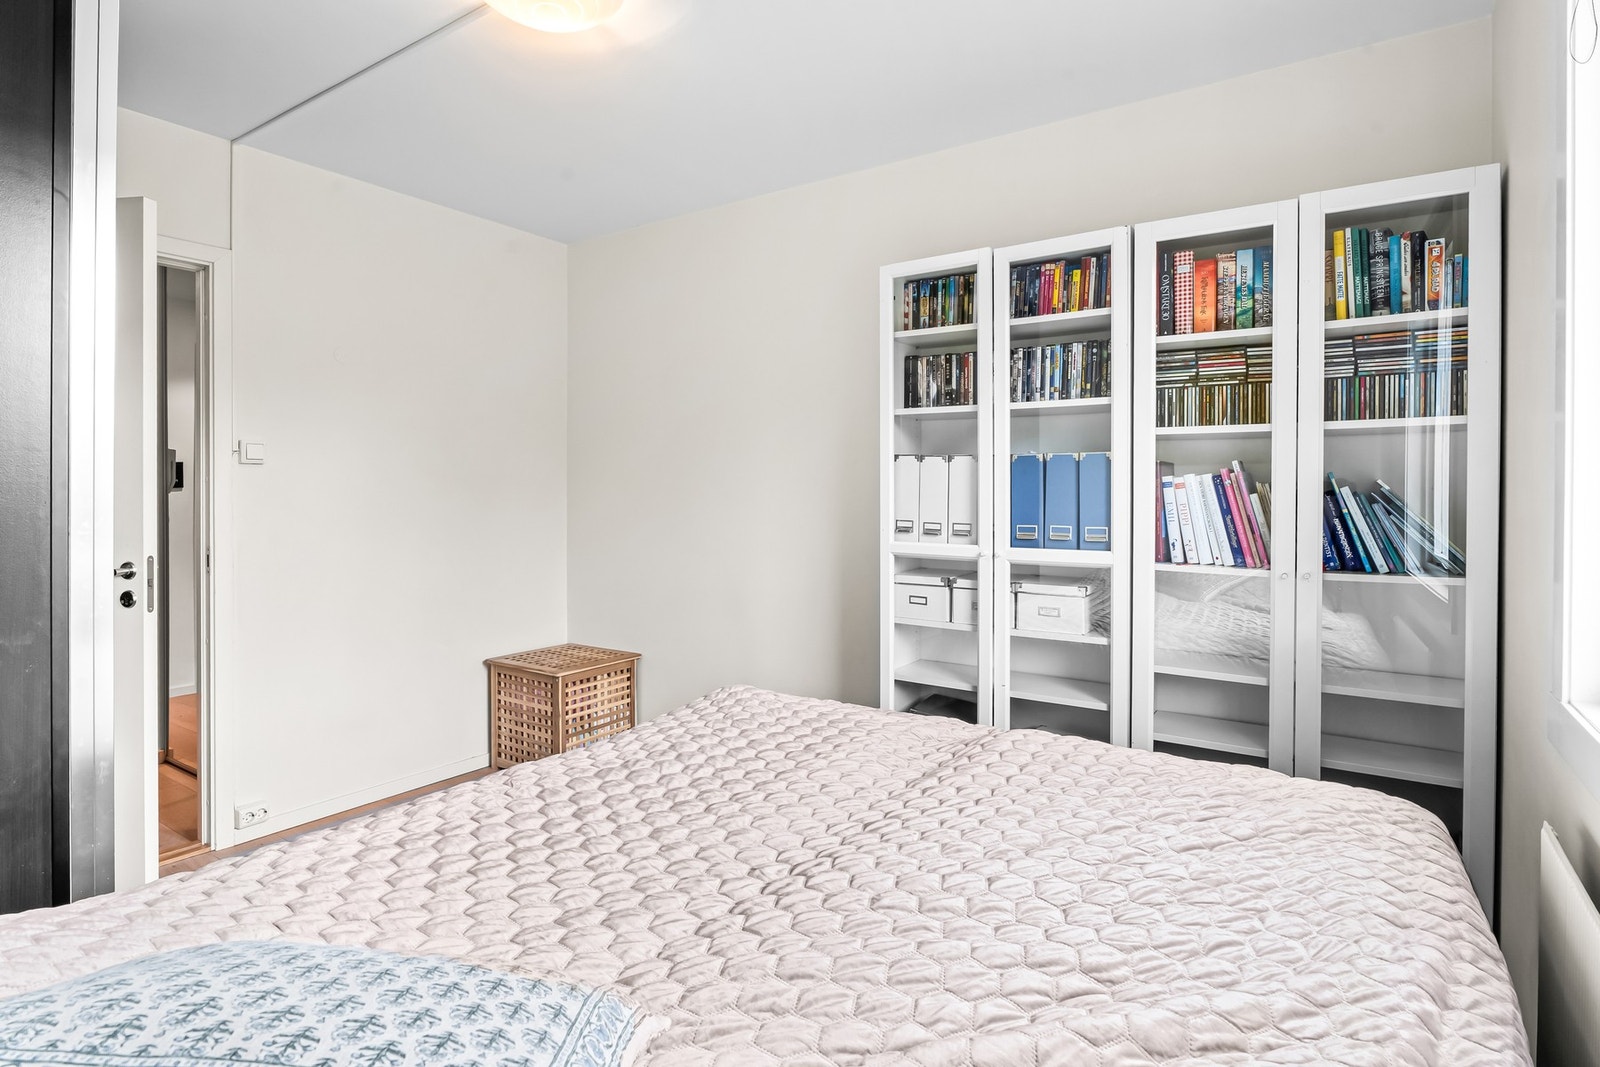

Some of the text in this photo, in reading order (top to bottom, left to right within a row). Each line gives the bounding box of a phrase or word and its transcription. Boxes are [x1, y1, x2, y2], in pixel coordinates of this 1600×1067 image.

[1374, 232, 1384, 253] BRUCE
[1375, 256, 1384, 298] SPRINGSTEEN
[1162, 311, 1170, 321] 30
[1179, 503, 1190, 527] PIPPI
